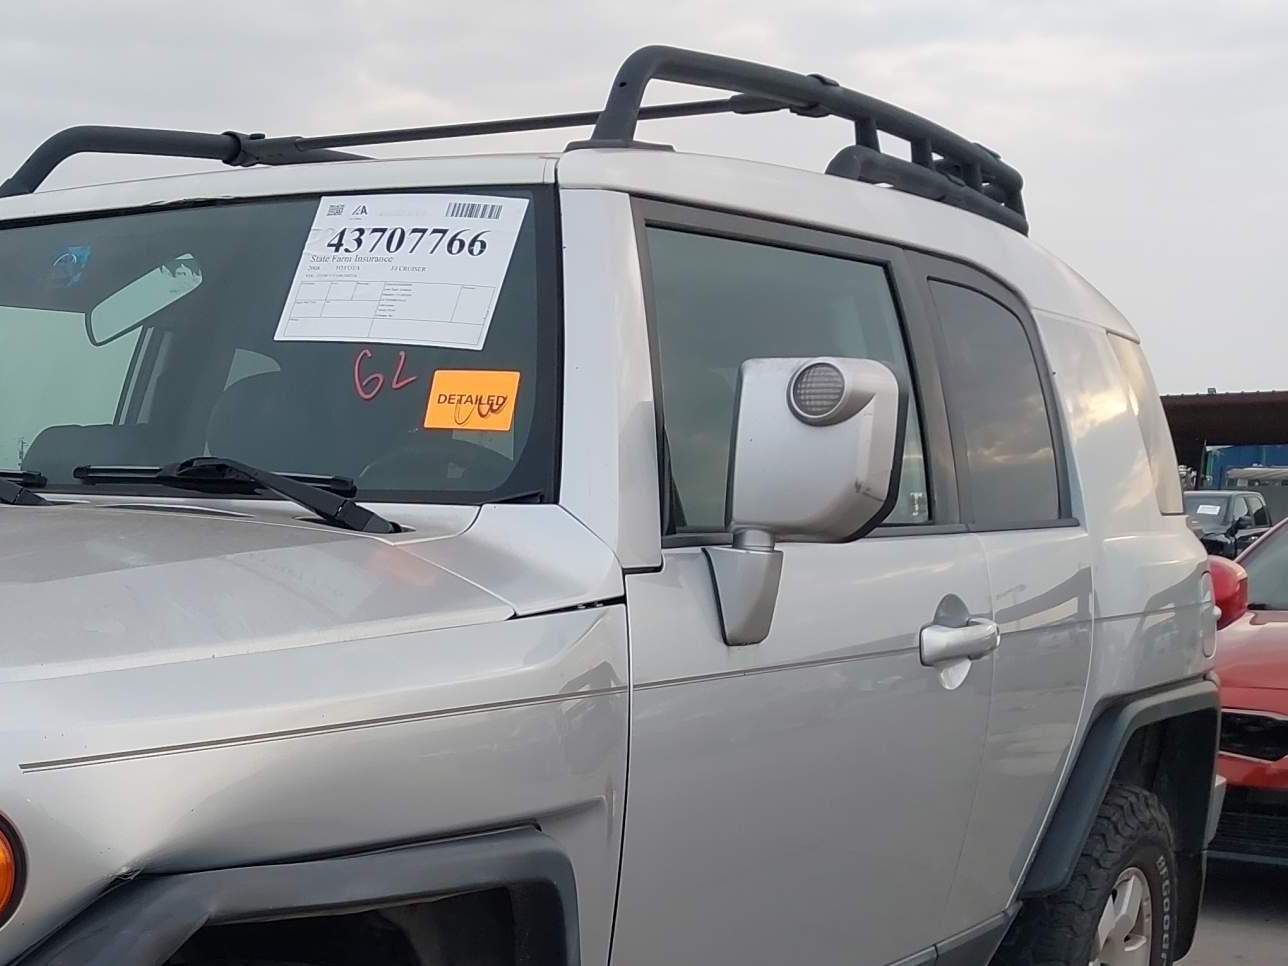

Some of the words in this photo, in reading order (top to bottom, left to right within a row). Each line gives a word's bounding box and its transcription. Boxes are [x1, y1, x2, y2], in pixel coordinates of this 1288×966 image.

[326, 227, 492, 257] 43707766
[310, 254, 330, 263] State
[331, 254, 353, 263] Farm
[354, 254, 394, 264] Insurance
[437, 393, 507, 406] DETAILED
